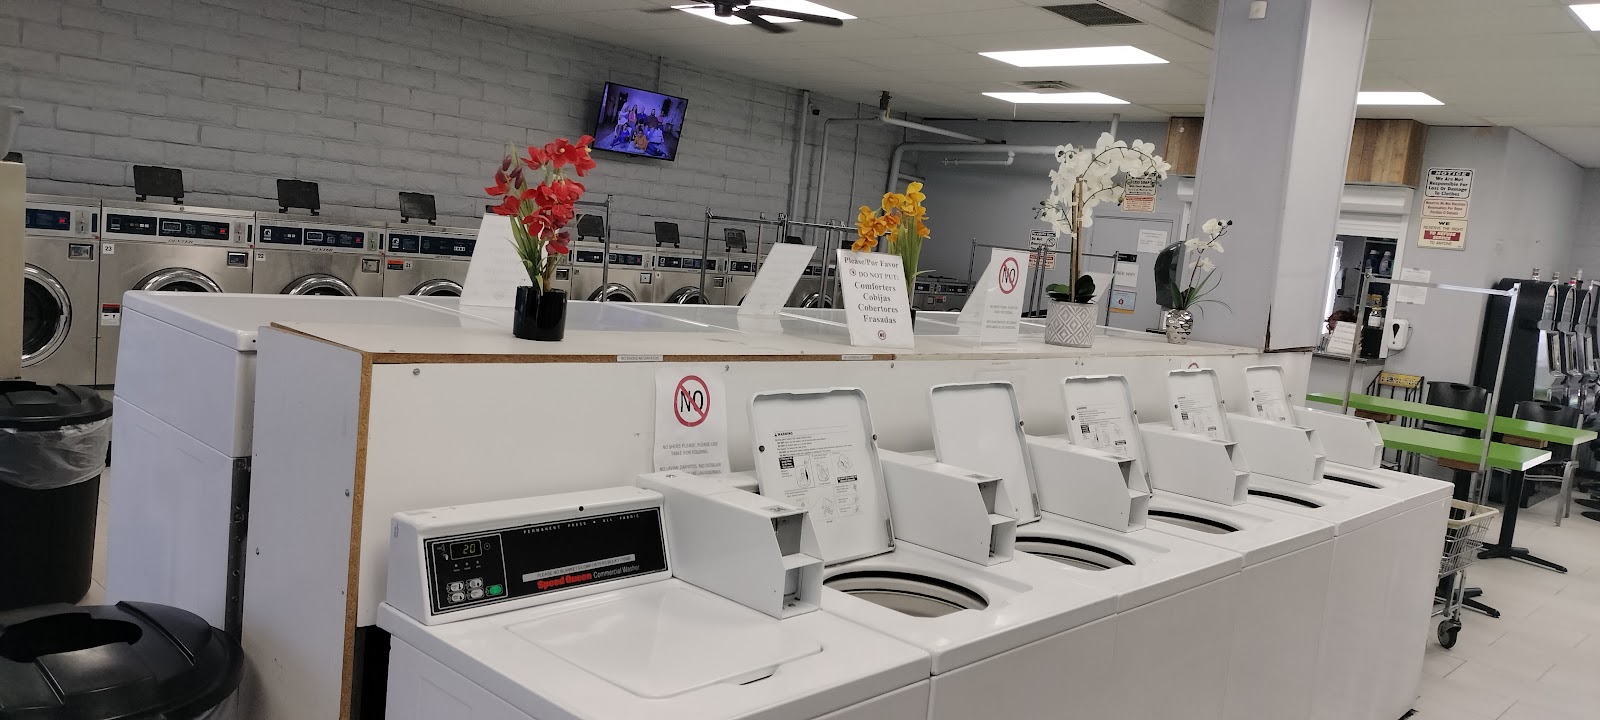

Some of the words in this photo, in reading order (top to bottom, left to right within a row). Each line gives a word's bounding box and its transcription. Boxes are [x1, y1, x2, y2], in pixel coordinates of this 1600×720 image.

[844, 256, 878, 266] Please/Por
[880, 259, 899, 269] Favor
[854, 281, 896, 292] Comforters
[862, 292, 891, 303] Cobijas
[857, 303, 898, 313] Cobertores
[863, 314, 897, 324] Frasadas
[680, 389, 704, 413] NO
[523, 525, 560, 534] PERMANENT
[463, 543, 476, 555] 20
[536, 576, 565, 590] Speed
[565, 572, 593, 584] Queen
[593, 567, 622, 579] Commercial
[622, 564, 641, 573] Washer
[537, 570, 553, 578] PLEASE
